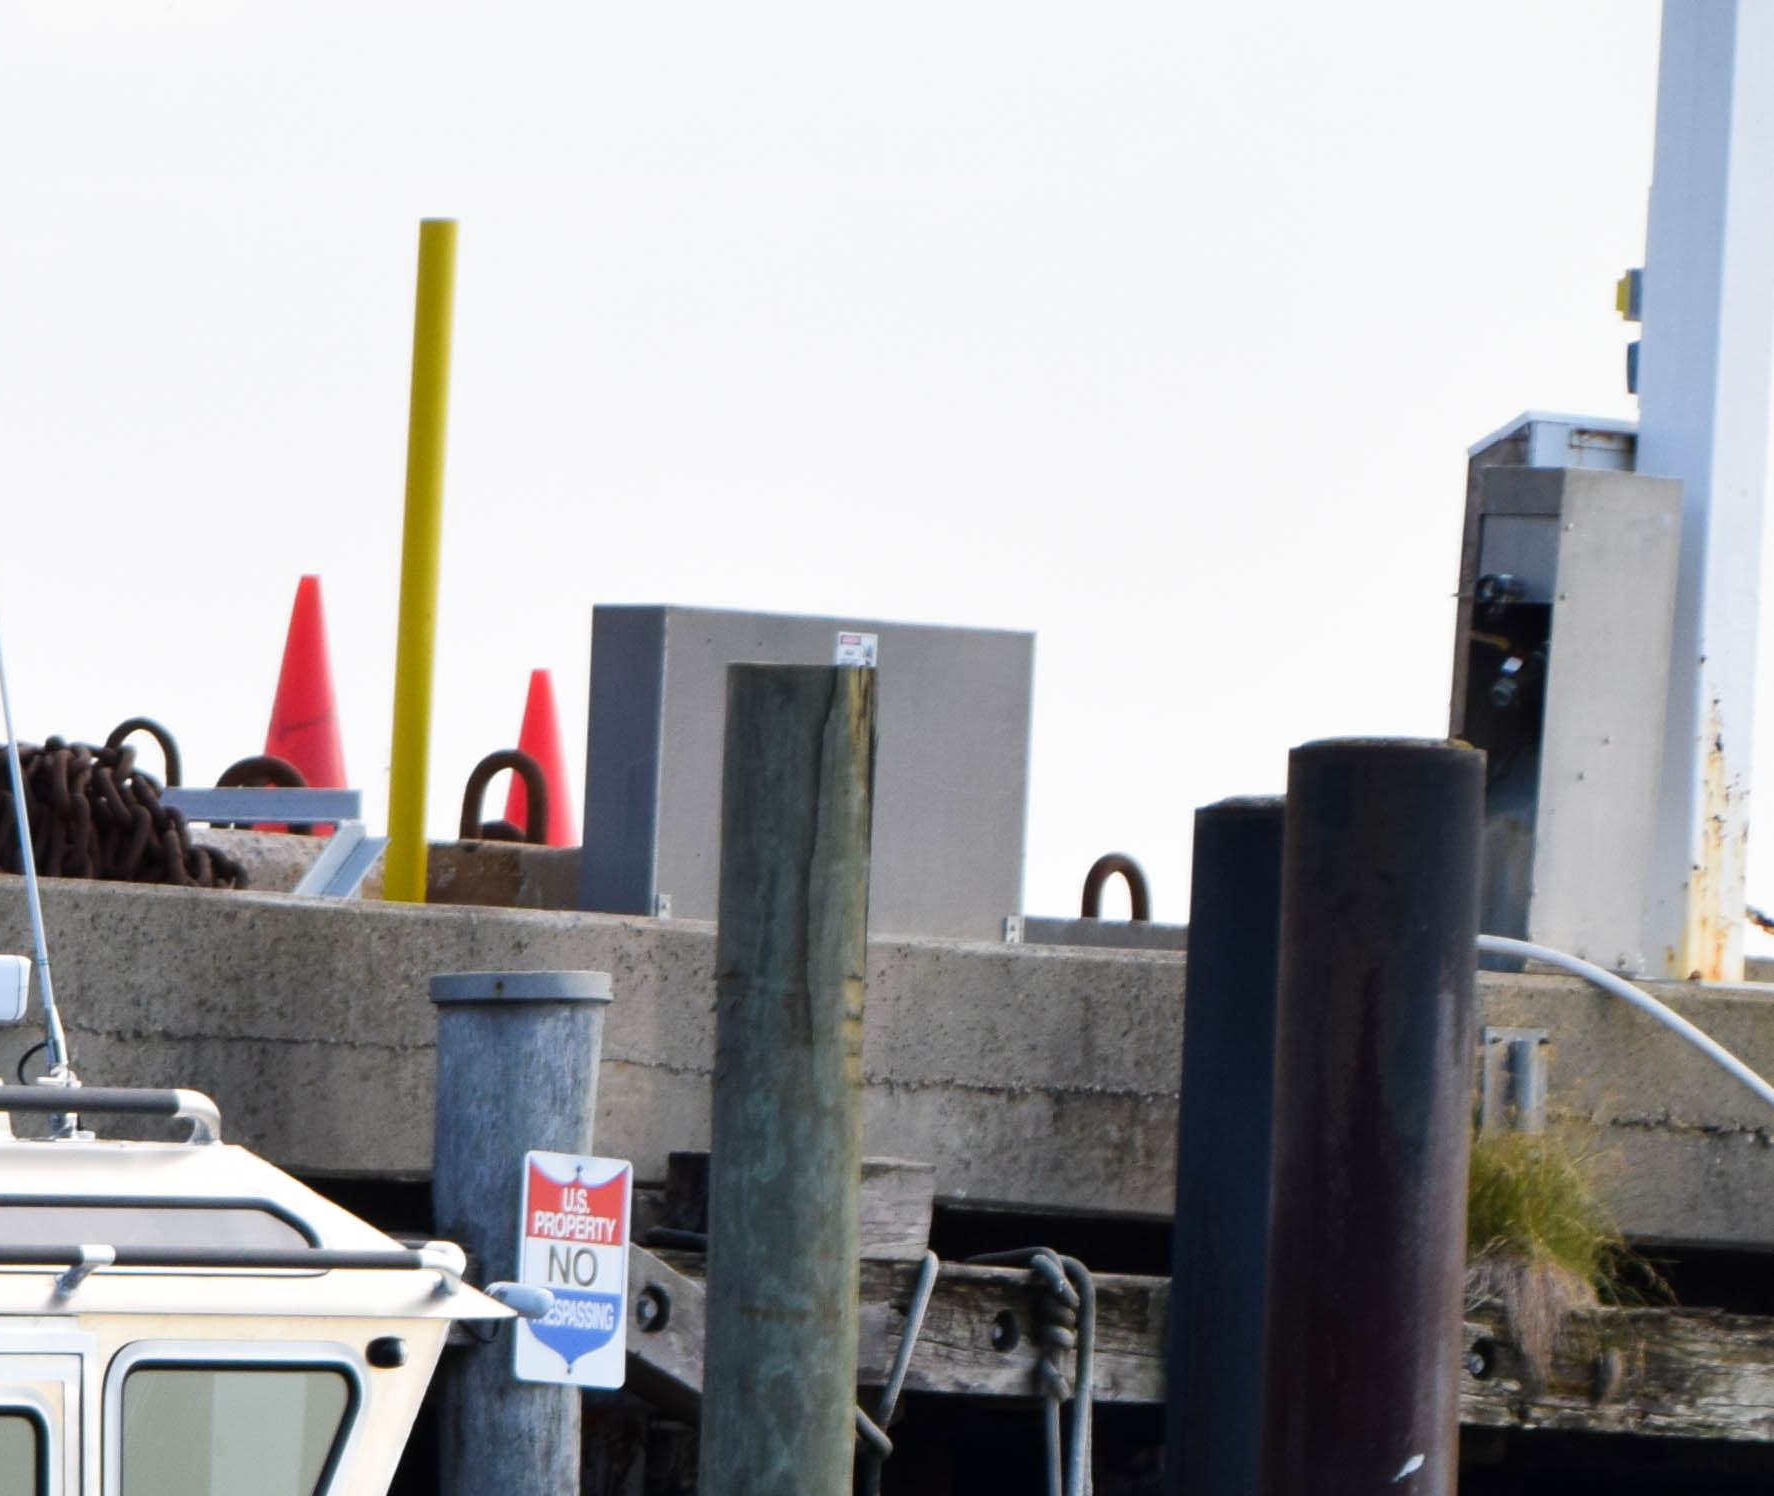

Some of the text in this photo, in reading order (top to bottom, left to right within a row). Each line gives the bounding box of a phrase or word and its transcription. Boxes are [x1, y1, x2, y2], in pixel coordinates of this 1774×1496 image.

[559, 1187, 590, 1214] U.S.
[532, 1211, 617, 1243] PROPERTY
[547, 1245, 598, 1288] NO
[533, 1300, 614, 1331] ESPASSING
